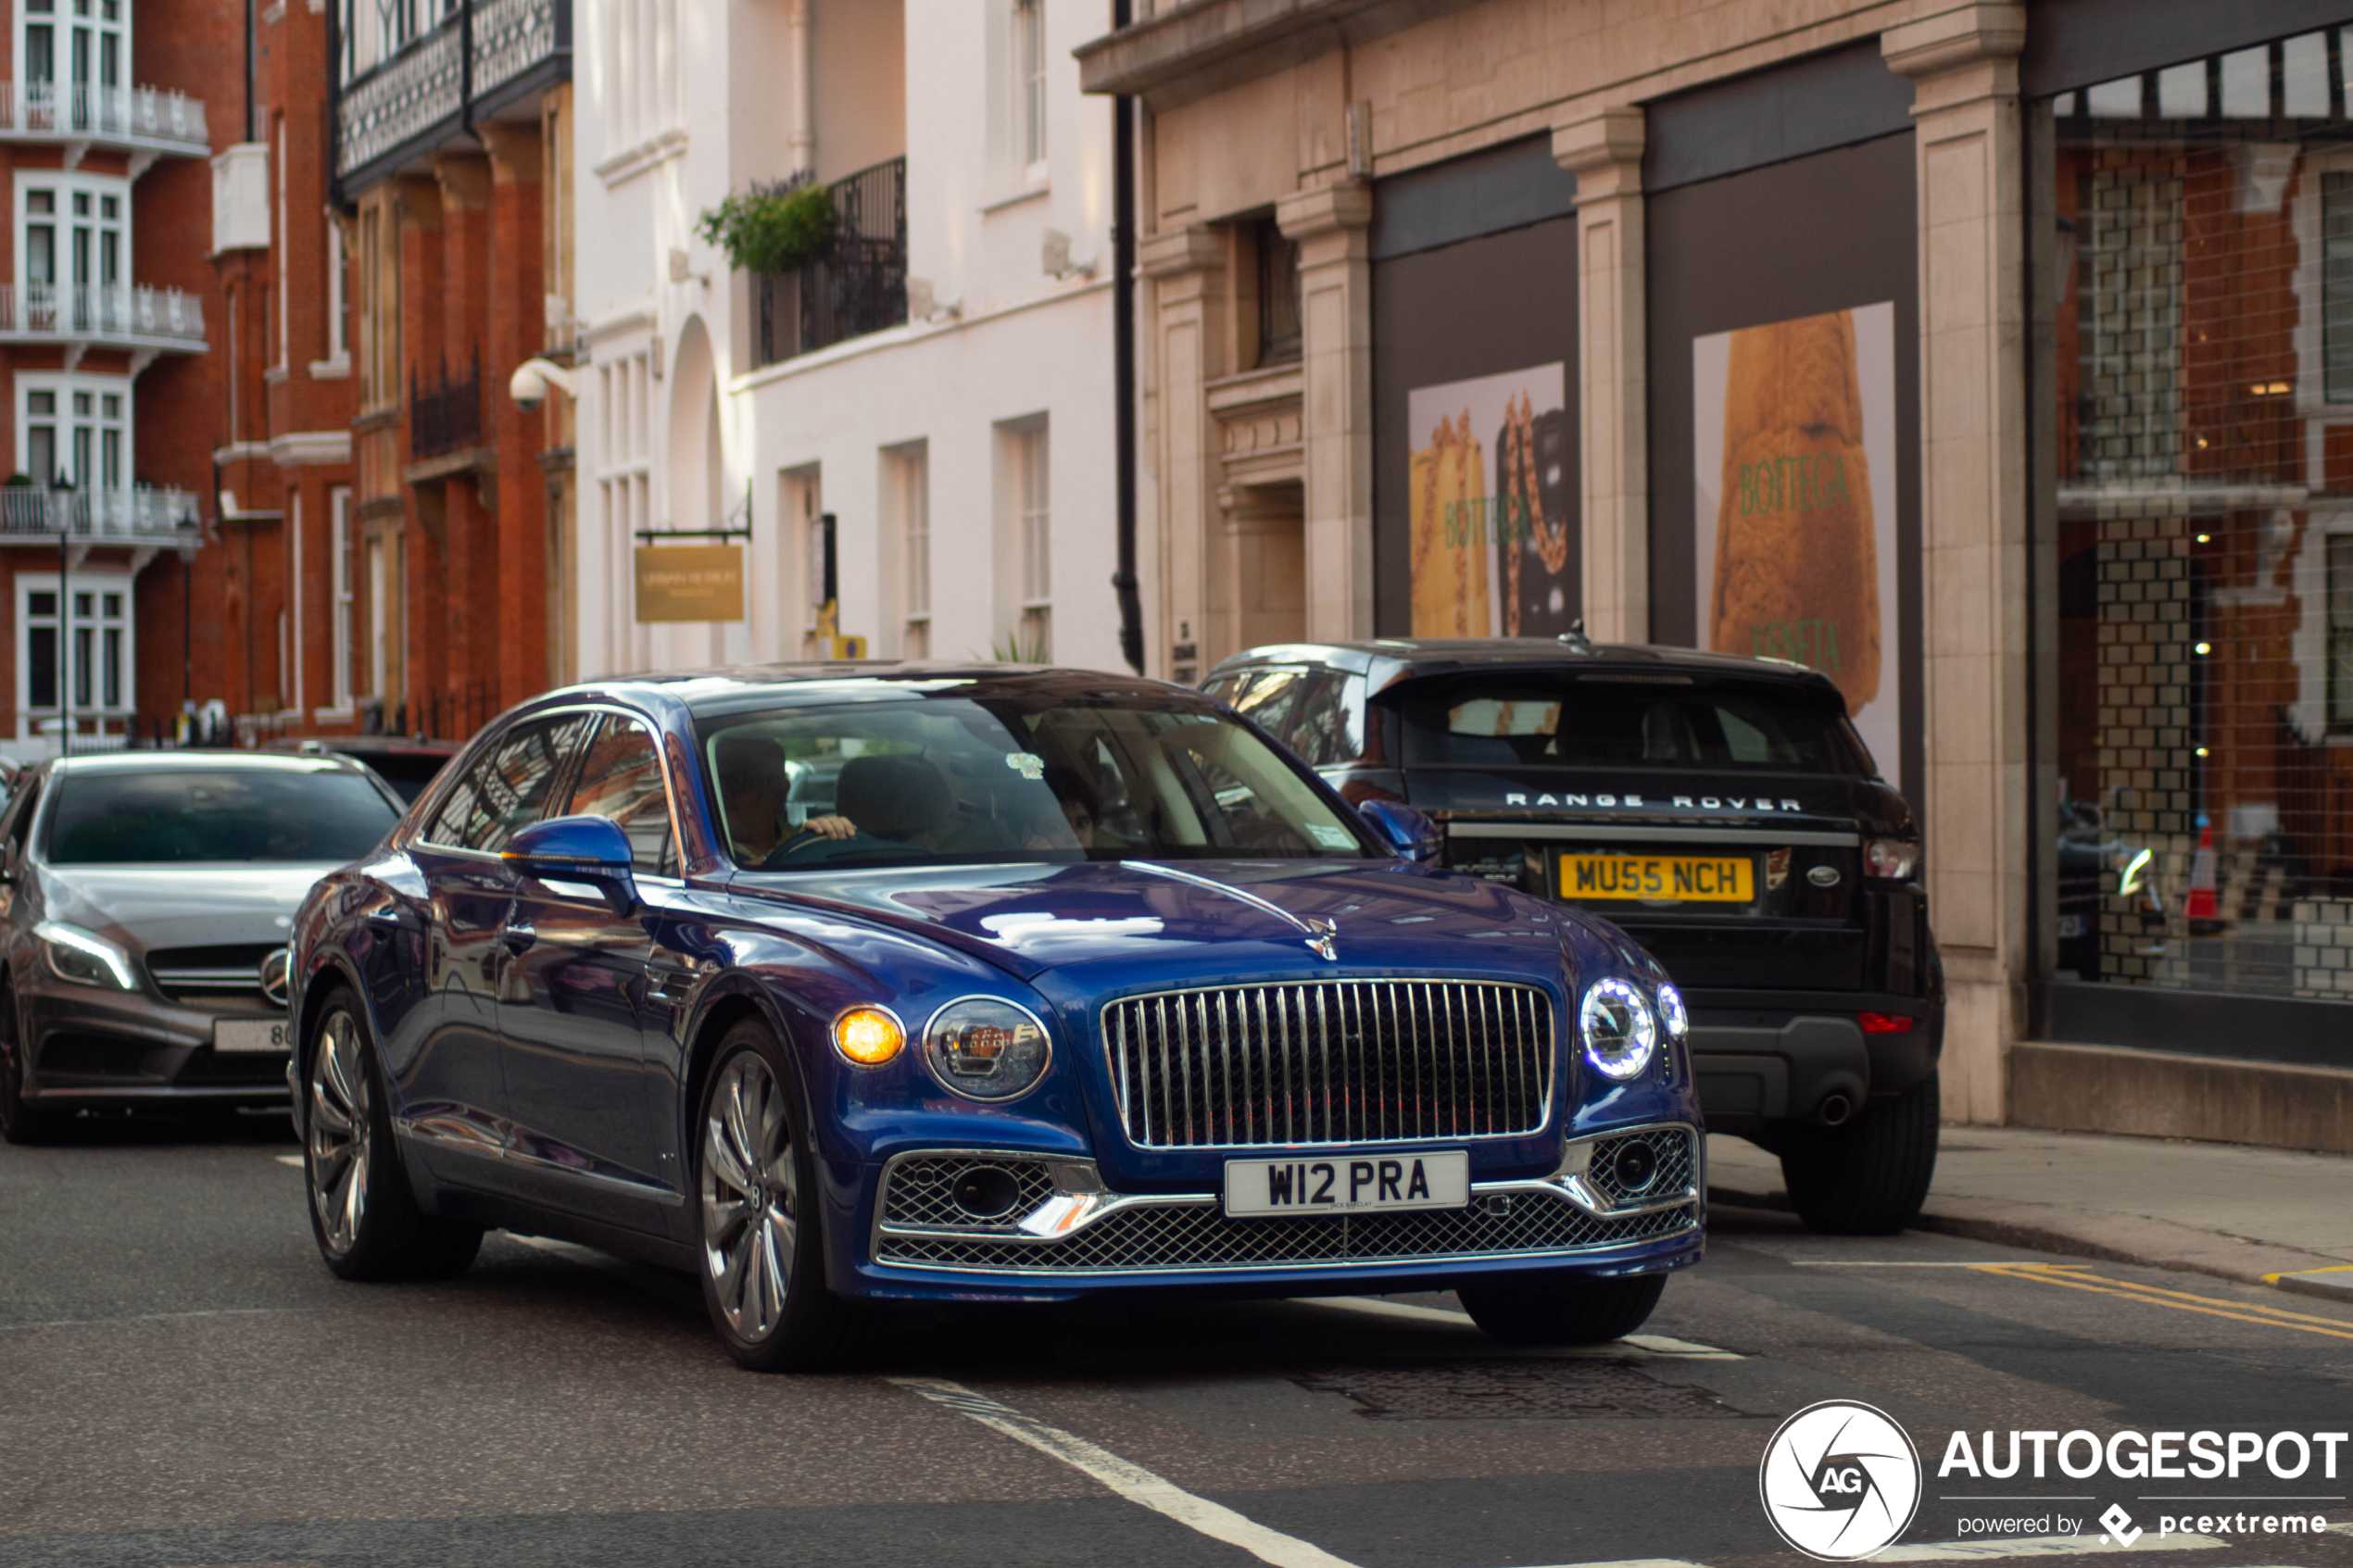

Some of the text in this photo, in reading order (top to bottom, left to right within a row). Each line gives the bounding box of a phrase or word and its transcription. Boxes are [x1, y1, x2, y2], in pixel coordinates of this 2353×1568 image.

[1741, 452, 1848, 517] BOTTEGA
[1445, 494, 1528, 550] BOTTEGA
[1752, 619, 1840, 672] VENETA
[1505, 793, 1802, 811] RANGE ROVER
[1577, 859, 1737, 894] MU55 NCH
[1268, 1159, 1429, 1205] W12 PRA
